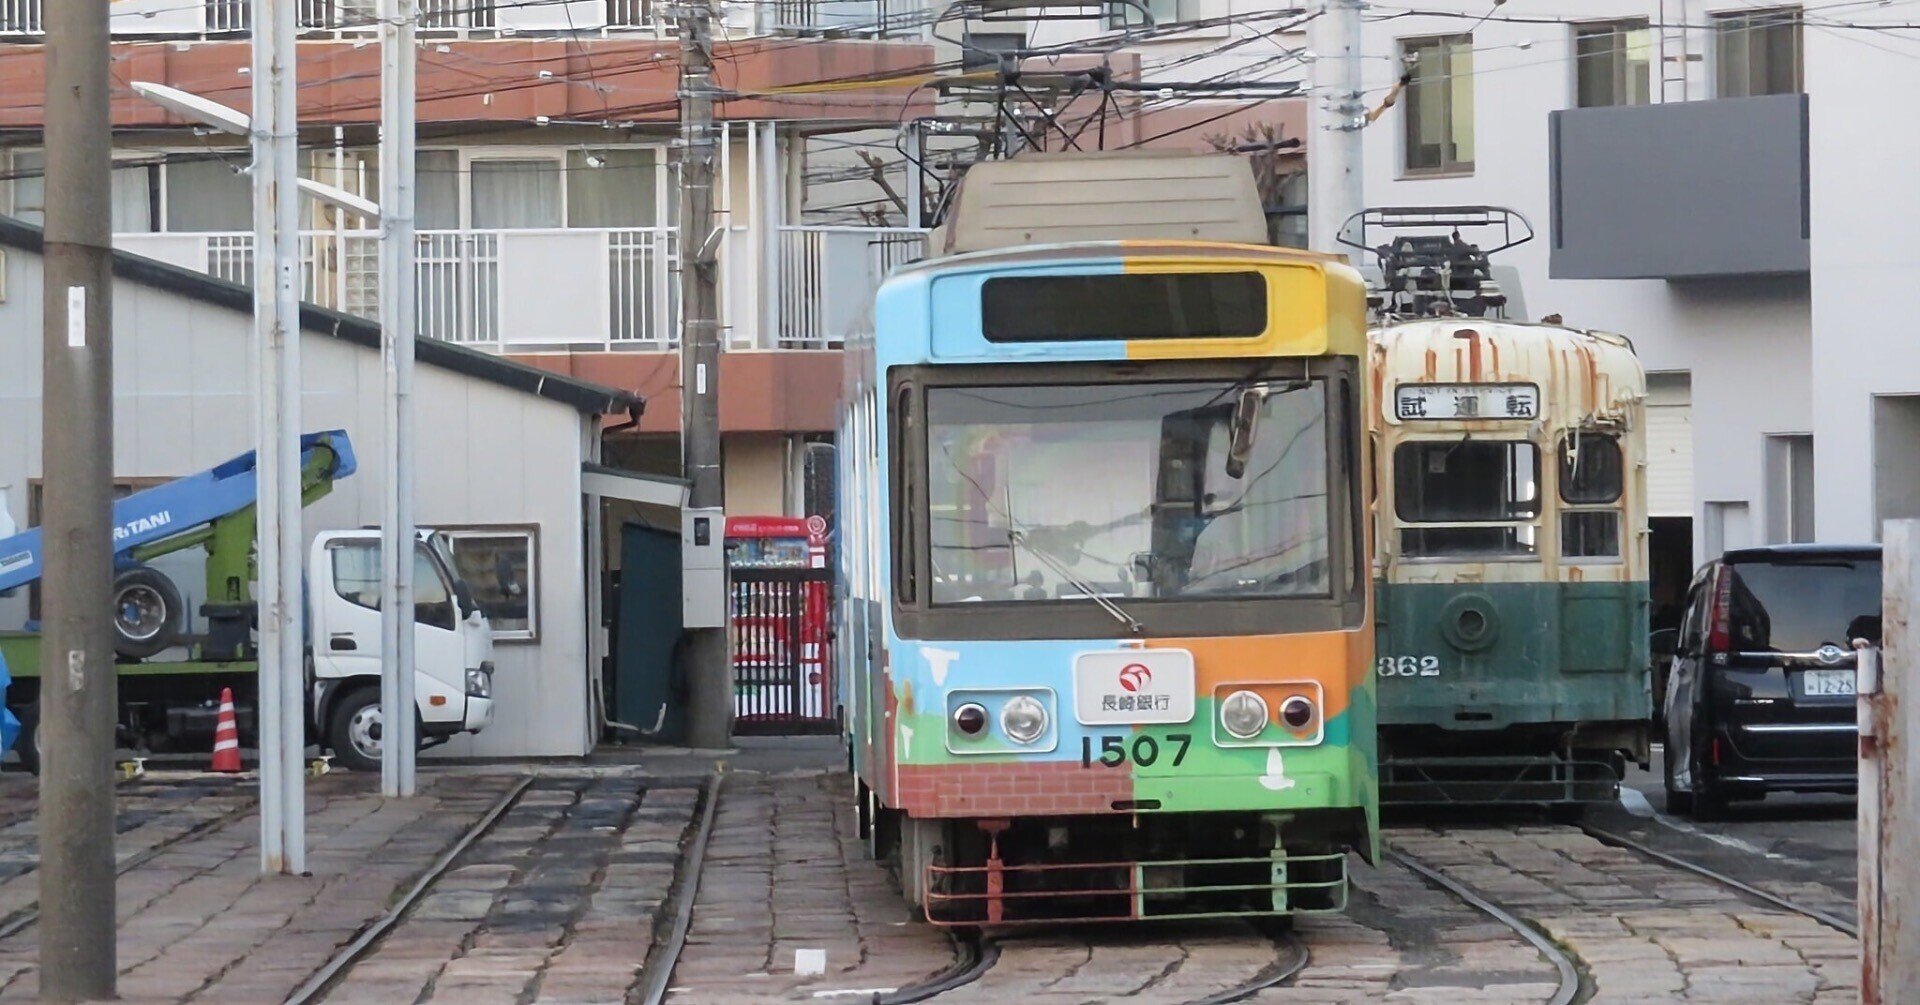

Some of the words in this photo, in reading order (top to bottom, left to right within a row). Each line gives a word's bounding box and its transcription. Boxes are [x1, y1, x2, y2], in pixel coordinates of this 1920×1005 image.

[1400, 396, 1532, 416] 試運転
[1378, 655, 1440, 677] 362
[1102, 694, 1170, 711] 長崎銀行
[1082, 734, 1192, 768] 1507
